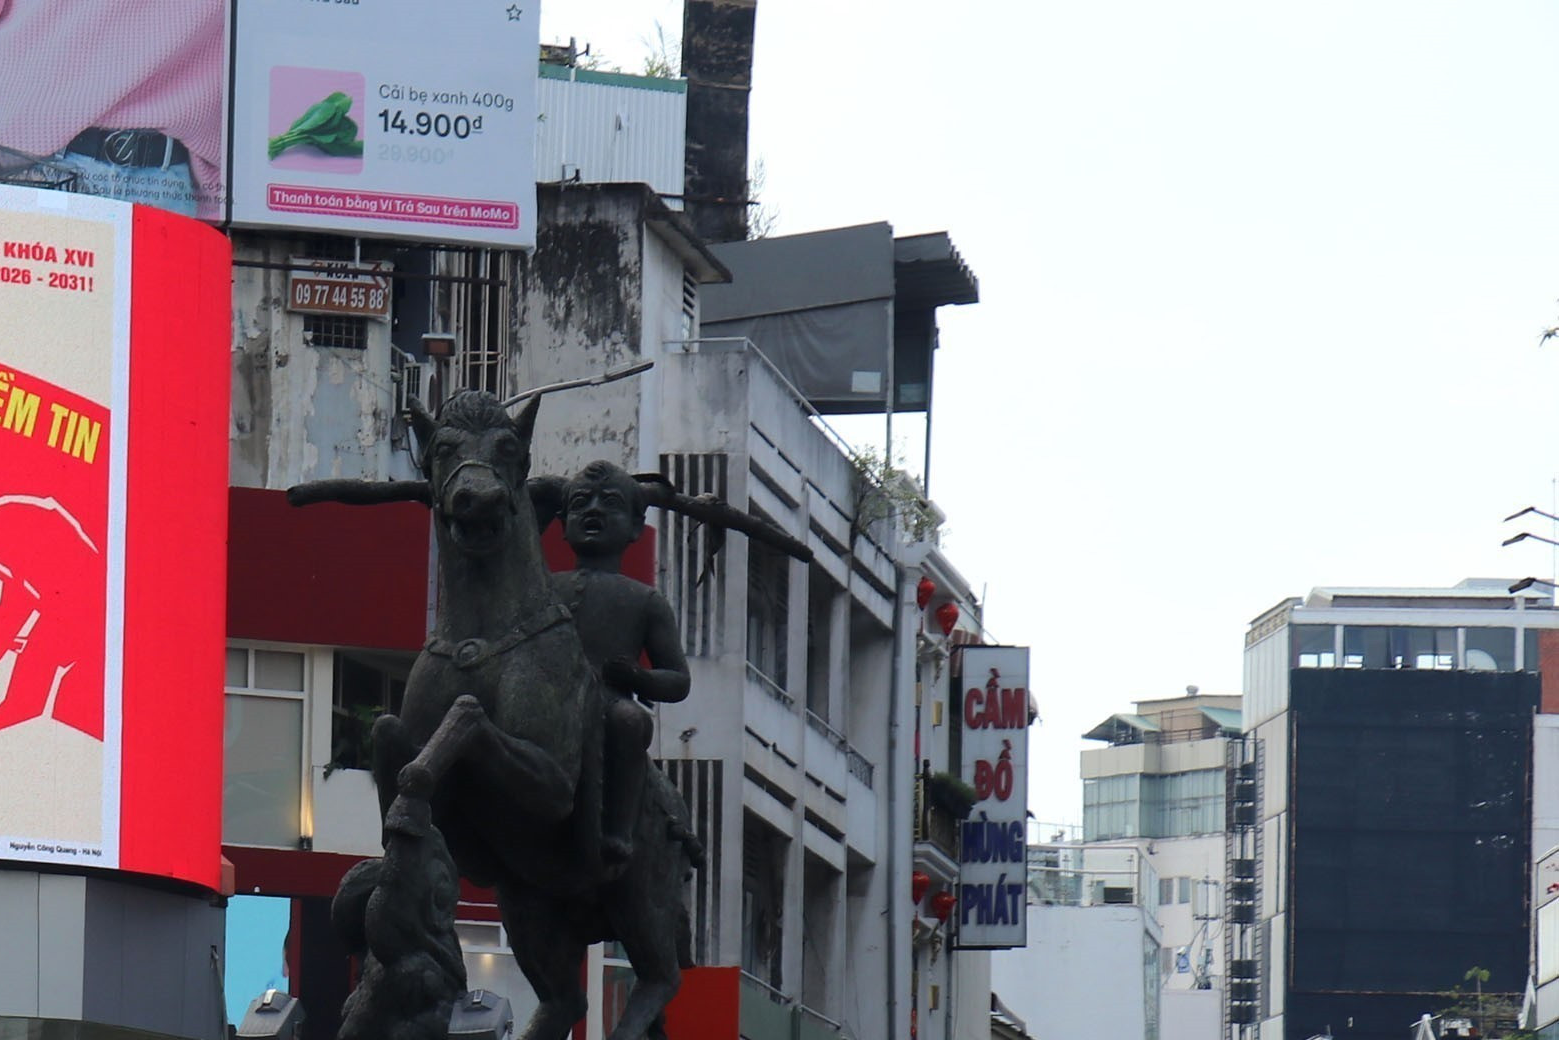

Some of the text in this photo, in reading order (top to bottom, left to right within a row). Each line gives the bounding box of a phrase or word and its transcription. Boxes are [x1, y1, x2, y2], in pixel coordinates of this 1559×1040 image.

[379, 84, 515, 112] Cải bẹ xanh 400g
[273, 190, 312, 206] Thanh
[315, 193, 342, 208] toán
[346, 194, 378, 213] bằng
[394, 199, 415, 213] Trả
[417, 202, 440, 215] Sau
[443, 203, 469, 218] trên
[470, 206, 511, 220] MoMo
[4, 238, 58, 263] KHÓA
[64, 249, 95, 268] XVI
[48, 272, 94, 293] 2031!
[296, 283, 384, 310] 09 77 44 55 88
[45, 403, 102, 465] TIN
[964, 667, 1025, 730] CẦM
[973, 739, 1015, 801] ĐỒ
[960, 810, 1024, 865] HÙNG
[960, 872, 1023, 928] PHÁT
